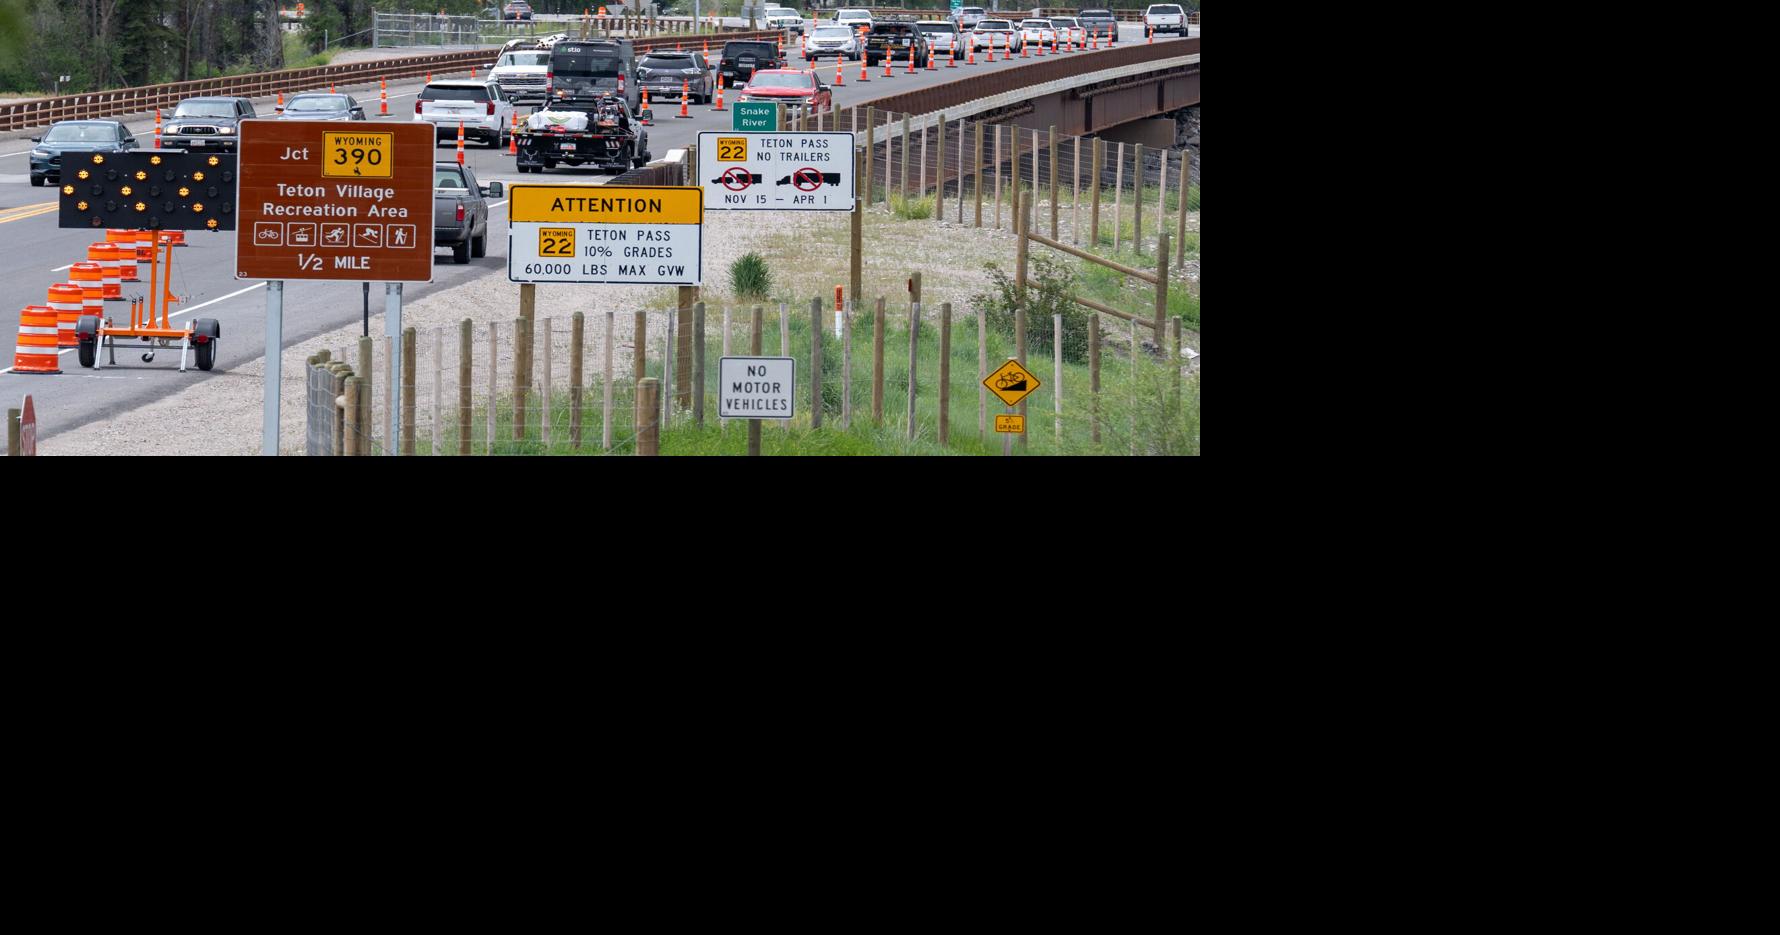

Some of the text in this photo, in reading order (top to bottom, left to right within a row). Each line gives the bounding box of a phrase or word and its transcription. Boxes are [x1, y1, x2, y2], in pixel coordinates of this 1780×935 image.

[334, 137, 382, 146] WYOMING
[761, 139, 829, 148] TETON PASS
[280, 147, 309, 160] Jct
[334, 148, 381, 165] 390
[720, 147, 744, 158] 22
[757, 153, 830, 161] NO TRAILERS
[277, 184, 394, 202] Teton Village
[725, 195, 747, 203] NOV
[756, 195, 767, 203] 15
[793, 196, 815, 204] APR
[824, 196, 827, 204] 1
[263, 203, 408, 217] Recreation Area
[551, 198, 662, 213] ATTENTION
[588, 230, 671, 241] TETON PASS
[542, 239, 572, 254] 22
[584, 246, 672, 257] 10% GRADES
[298, 253, 370, 271] 1/2 MILE
[582, 264, 608, 275] LBS
[618, 265, 646, 276] MAX
[658, 266, 684, 276] GVW
[747, 365, 766, 376] NO
[733, 382, 781, 393] MOTOR
[726, 399, 787, 410] VEHICLES
